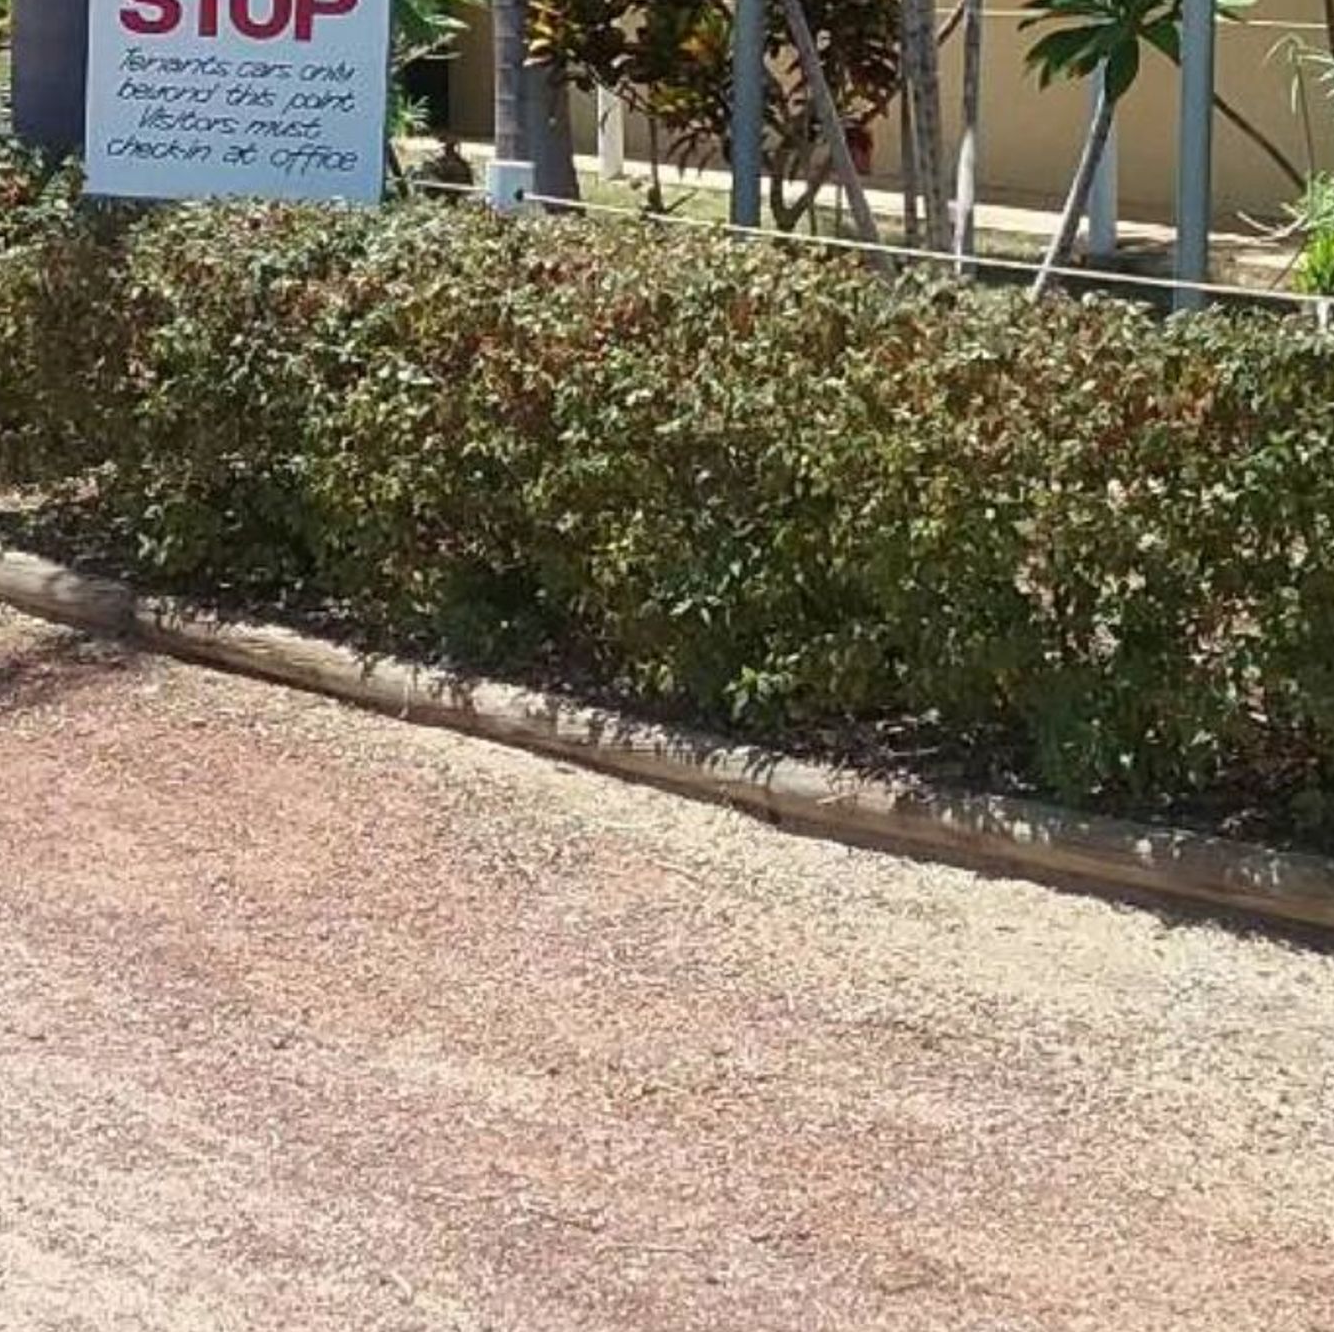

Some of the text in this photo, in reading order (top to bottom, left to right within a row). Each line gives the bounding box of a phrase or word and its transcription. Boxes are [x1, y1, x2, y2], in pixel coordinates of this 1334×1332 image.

[120, 46, 357, 83] Tenants cars only
[116, 77, 357, 115] beyond this point
[138, 104, 323, 140] Visitors must
[222, 142, 259, 166] at
[269, 144, 359, 177] office
